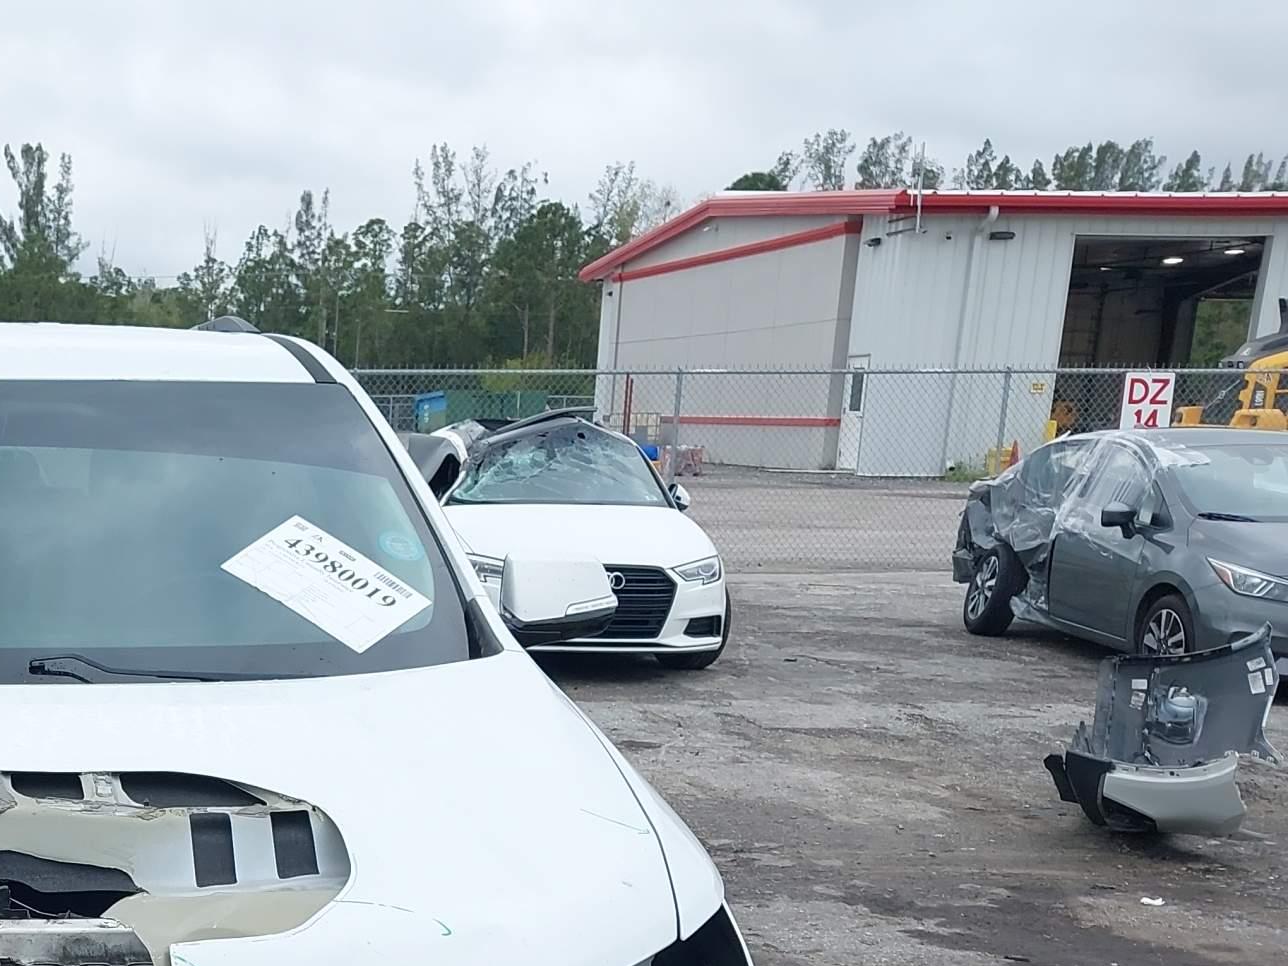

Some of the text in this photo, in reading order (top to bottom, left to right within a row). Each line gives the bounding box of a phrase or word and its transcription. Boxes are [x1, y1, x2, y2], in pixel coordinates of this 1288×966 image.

[1127, 377, 1171, 405] DZ
[1133, 408, 1159, 428] 14
[283, 536, 397, 608] 43980019
